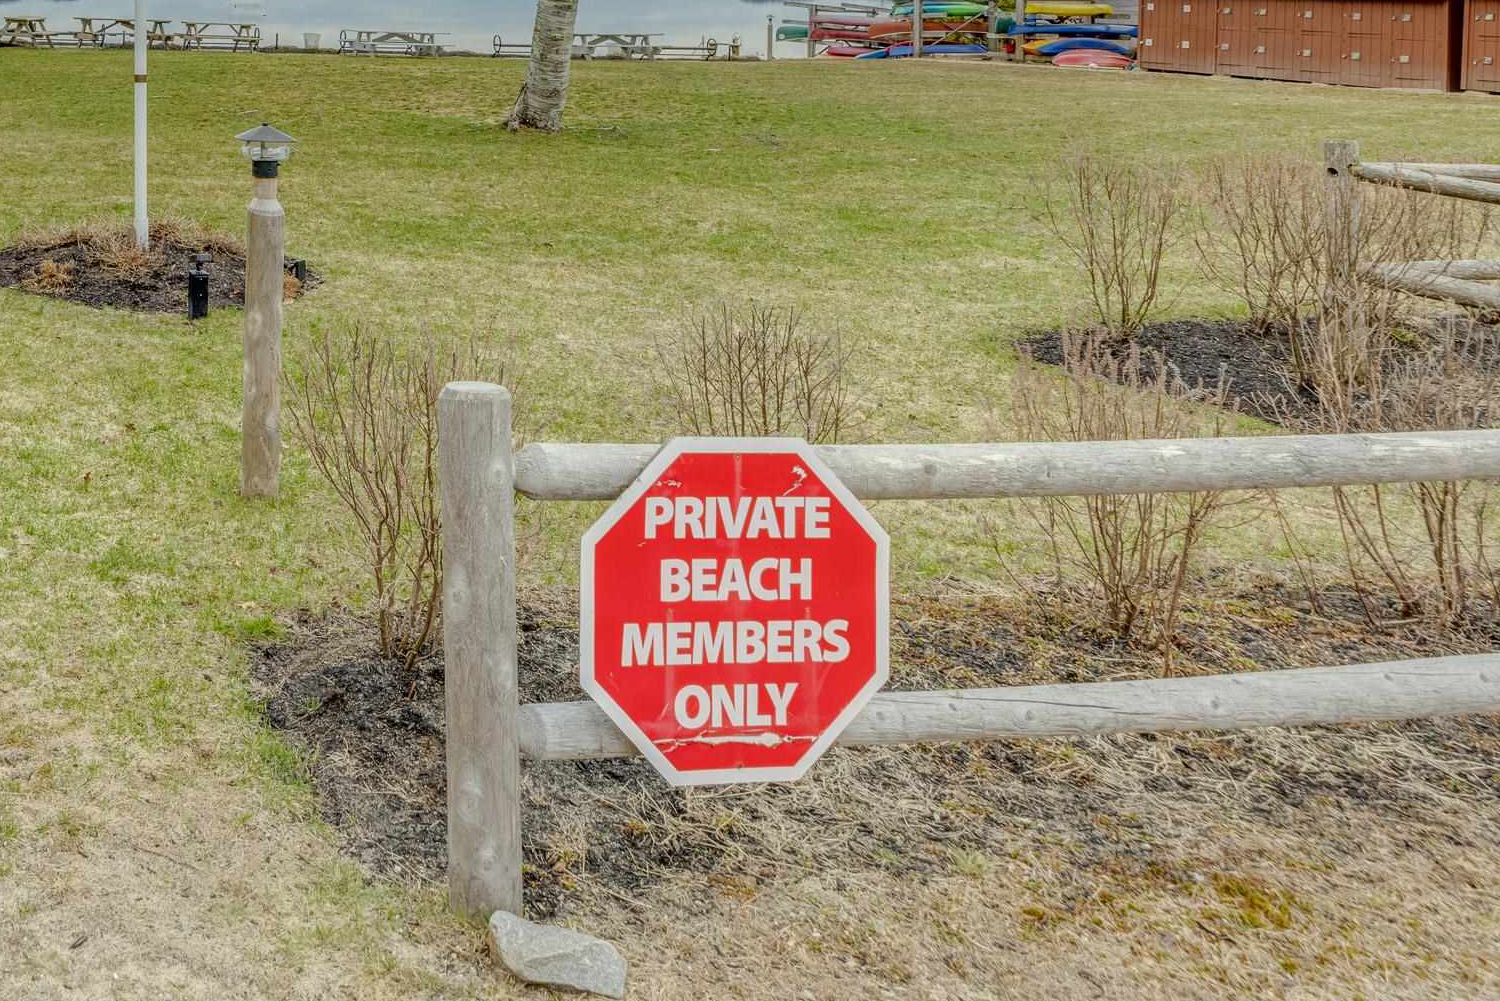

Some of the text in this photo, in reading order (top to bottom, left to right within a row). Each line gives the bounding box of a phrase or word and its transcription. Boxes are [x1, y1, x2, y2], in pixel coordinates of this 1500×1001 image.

[644, 496, 830, 540] PRIVATE
[660, 558, 812, 602] BEACH
[621, 620, 850, 667] MEMBERS
[674, 683, 798, 728] ONLY
